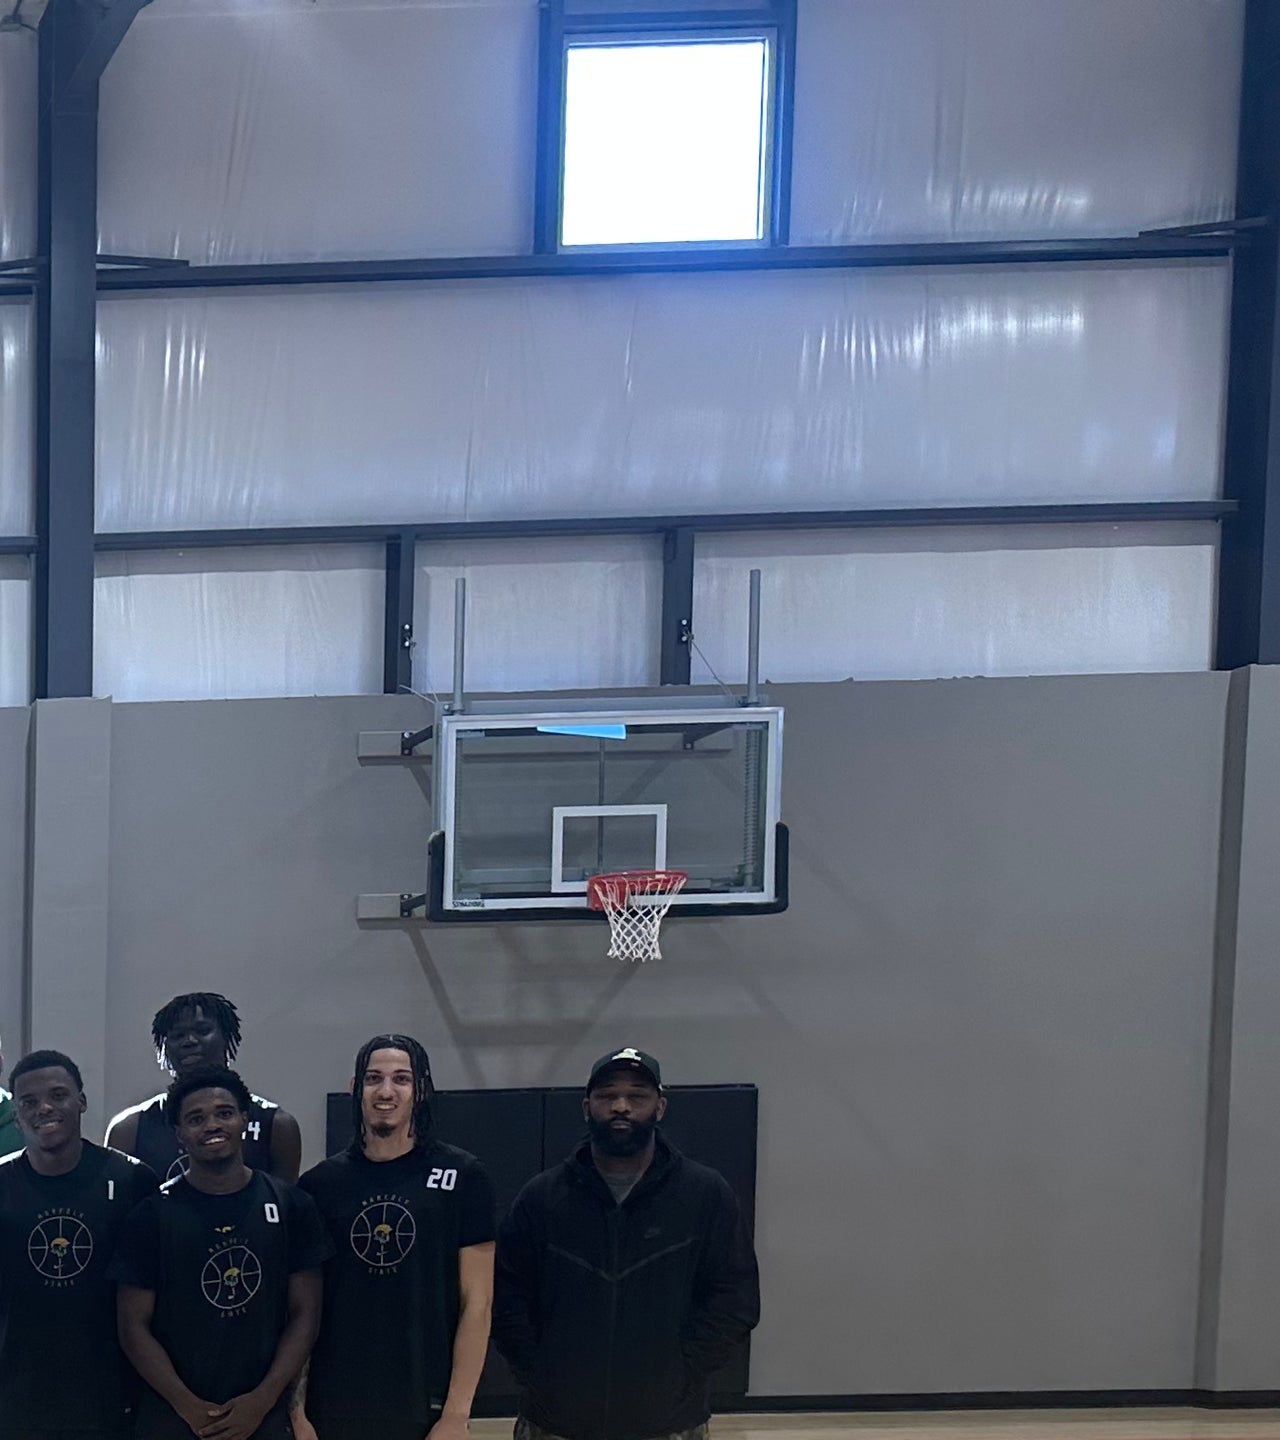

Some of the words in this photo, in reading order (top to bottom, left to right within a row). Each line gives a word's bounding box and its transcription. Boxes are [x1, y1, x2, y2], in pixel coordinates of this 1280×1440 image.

[426, 1168, 458, 1191] 20
[108, 1180, 115, 1200] 1
[264, 1203, 280, 1223] 0
